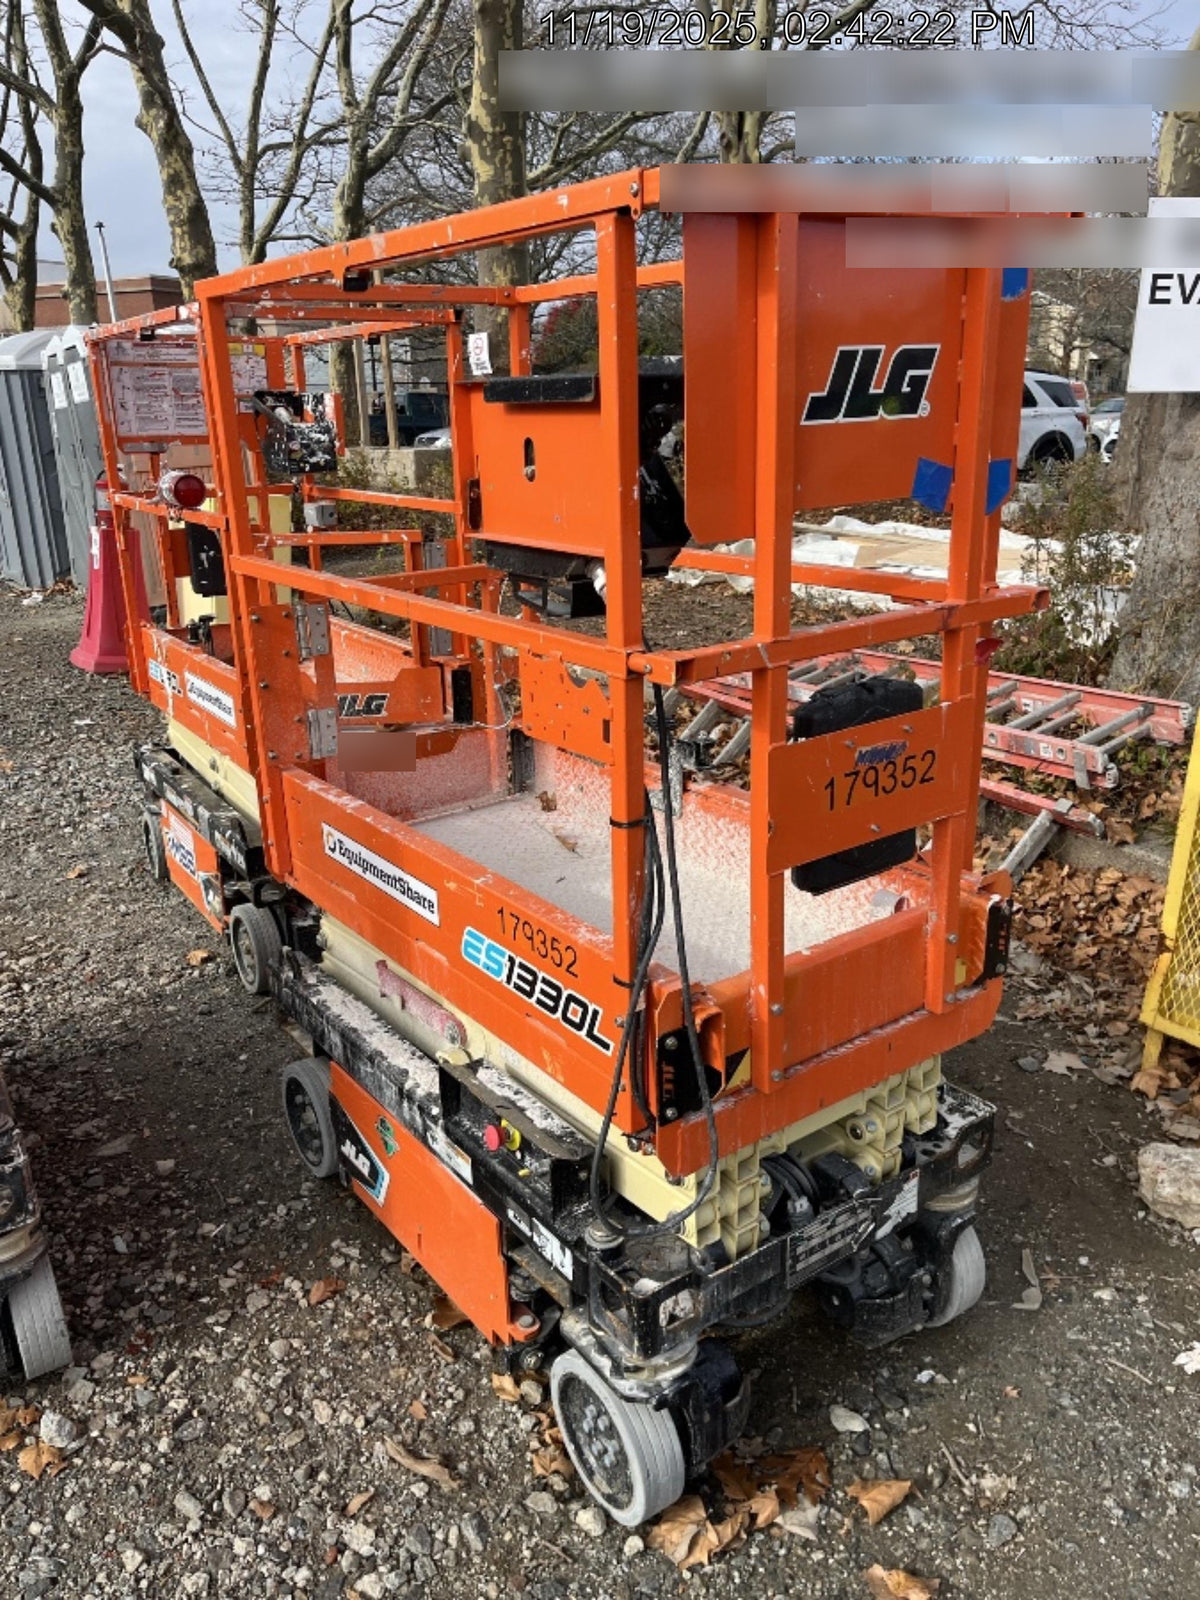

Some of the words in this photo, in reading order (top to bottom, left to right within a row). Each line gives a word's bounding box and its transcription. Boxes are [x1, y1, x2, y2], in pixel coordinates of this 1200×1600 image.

[1148, 273, 1200, 305] EV
[800, 343, 942, 425] JLG
[824, 750, 937, 811] 179352
[336, 838, 436, 915] EquipmentShare
[496, 906, 579, 979] 179352
[461, 925, 615, 1057] ES1330L
